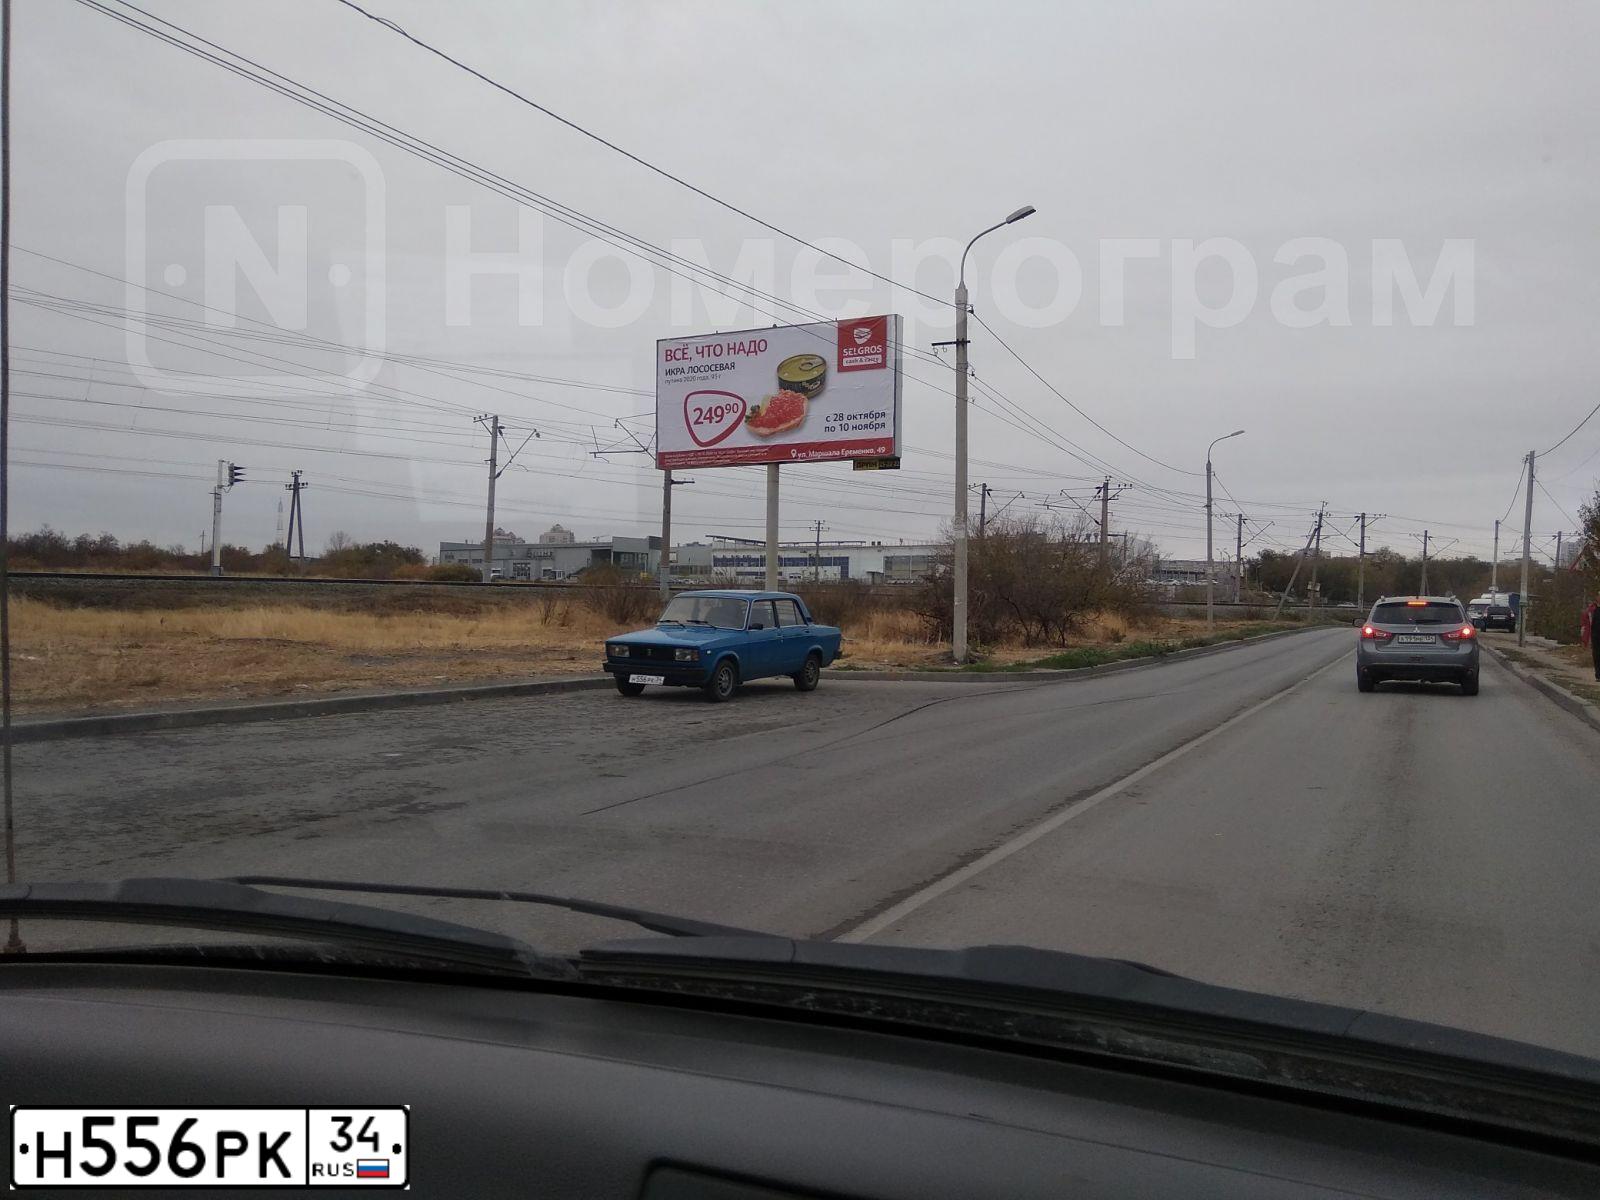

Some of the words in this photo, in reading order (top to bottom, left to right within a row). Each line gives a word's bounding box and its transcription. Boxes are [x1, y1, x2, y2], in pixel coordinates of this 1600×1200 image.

[665, 344, 692, 362] ВСЁ,
[696, 344, 723, 358] ЧТО
[727, 339, 768, 356] НАДО
[843, 345, 882, 356] SELGROS
[665, 368, 685, 376] ИКРА
[687, 362, 735, 374] ЛОСОСЕВАЯ
[683, 375, 697, 383] 2020
[833, 413, 844, 422] 28
[846, 410, 886, 421] октября
[839, 423, 850, 432] 10
[851, 421, 886, 431] ноября
[808, 450, 840, 459] Маршала
[841, 448, 876, 457] Еременко,
